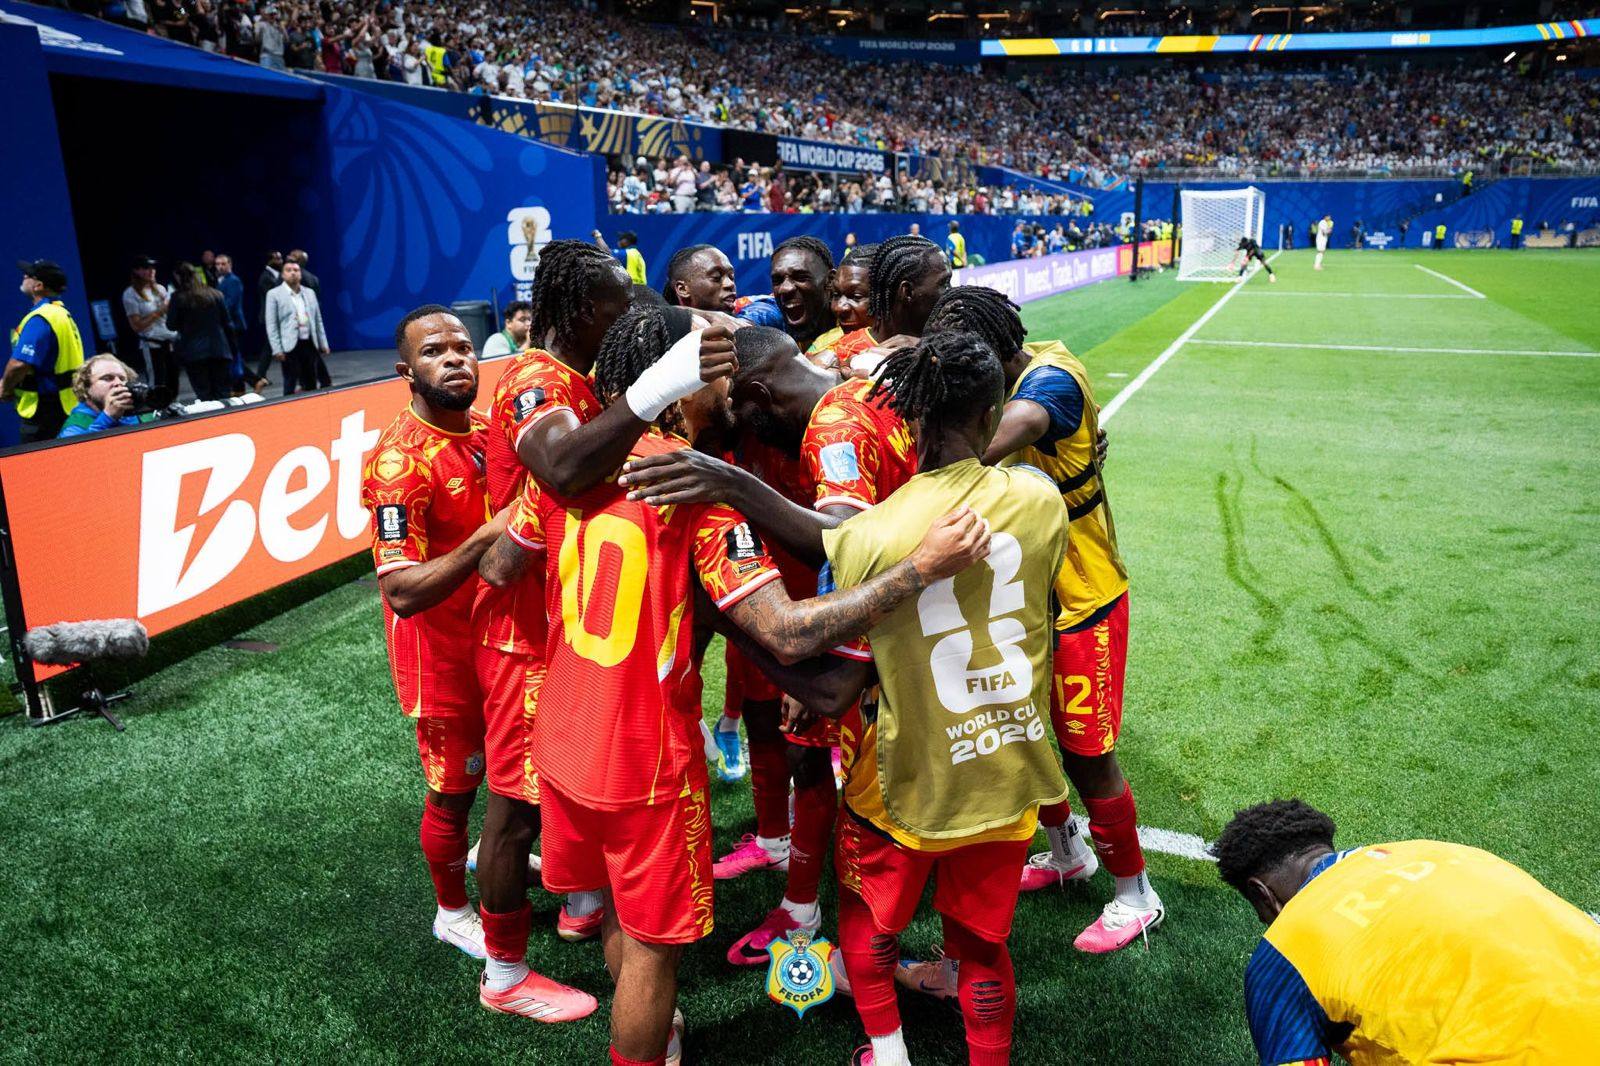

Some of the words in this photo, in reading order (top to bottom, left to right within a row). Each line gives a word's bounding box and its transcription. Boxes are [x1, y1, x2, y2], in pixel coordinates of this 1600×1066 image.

[859, 40, 878, 49] FIFA
[879, 41, 908, 50] WORLD
[909, 42, 927, 50] CUP
[927, 42, 956, 51] 2026
[799, 144, 836, 167] WORLD
[837, 149, 855, 169] CUP
[855, 152, 885, 172] 2026
[1571, 196, 1598, 208] FIFA
[738, 231, 774, 260] FIFA
[558, 507, 649, 668] 10
[966, 670, 1017, 694] FIFA
[1055, 674, 1093, 715] 12
[945, 709, 1011, 741] WORLD
[949, 715, 1046, 766] 2026
